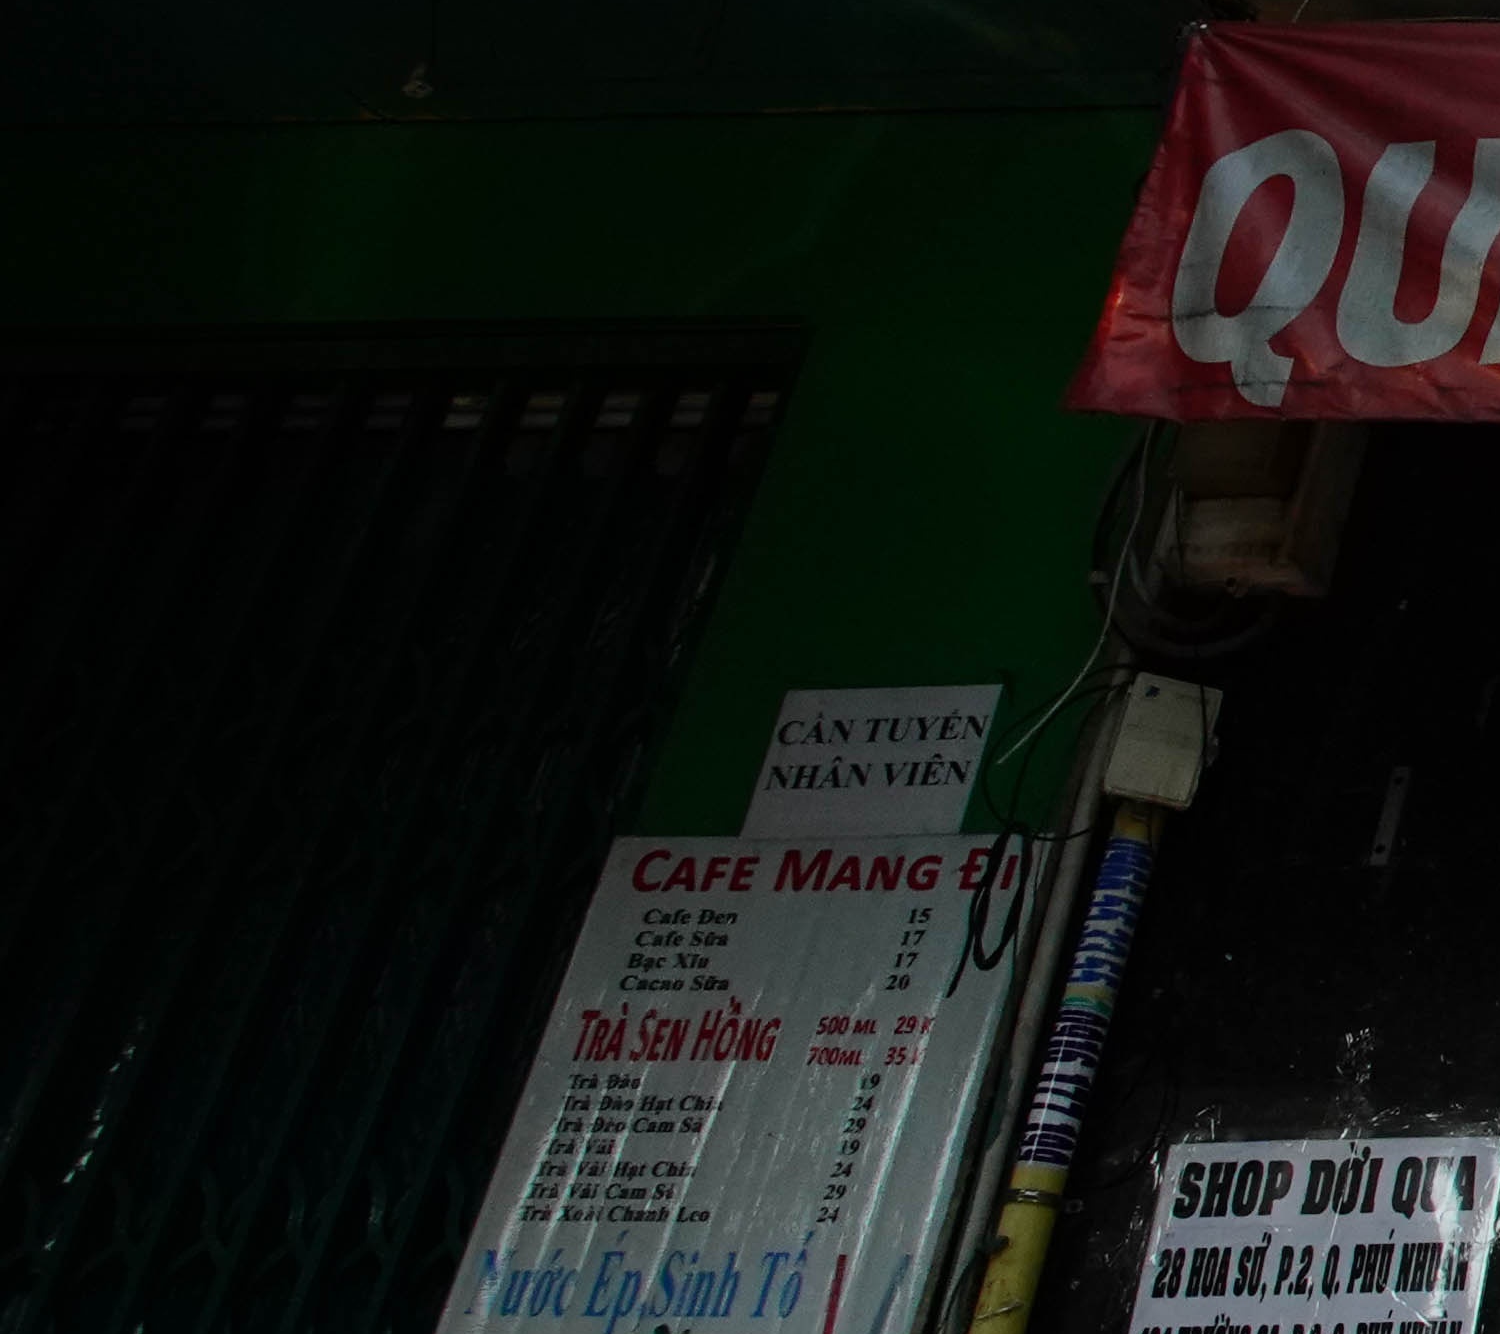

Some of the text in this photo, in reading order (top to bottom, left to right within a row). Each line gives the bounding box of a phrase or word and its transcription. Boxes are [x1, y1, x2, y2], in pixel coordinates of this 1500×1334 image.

[763, 753, 971, 790] NHÂN VIÊN
[632, 849, 760, 892] CAFE
[774, 849, 943, 892] MANG
[907, 908, 933, 924] 15
[901, 930, 925, 947] 17
[894, 953, 919, 969] 17
[885, 975, 911, 991] 20
[816, 1016, 850, 1035] 500
[894, 1016, 917, 1035] 29
[853, 1095, 874, 1112] 24
[843, 1117, 867, 1133] 29
[830, 1161, 853, 1177] 24
[823, 1183, 847, 1199] 29
[1172, 1159, 1294, 1219] SHOP
[1391, 1155, 1478, 1220] QUA
[816, 1205, 841, 1222] 24
[1151, 1248, 1182, 1299] 28
[1186, 1246, 1232, 1297] HOA
[1347, 1228, 1397, 1294] PHÚ
